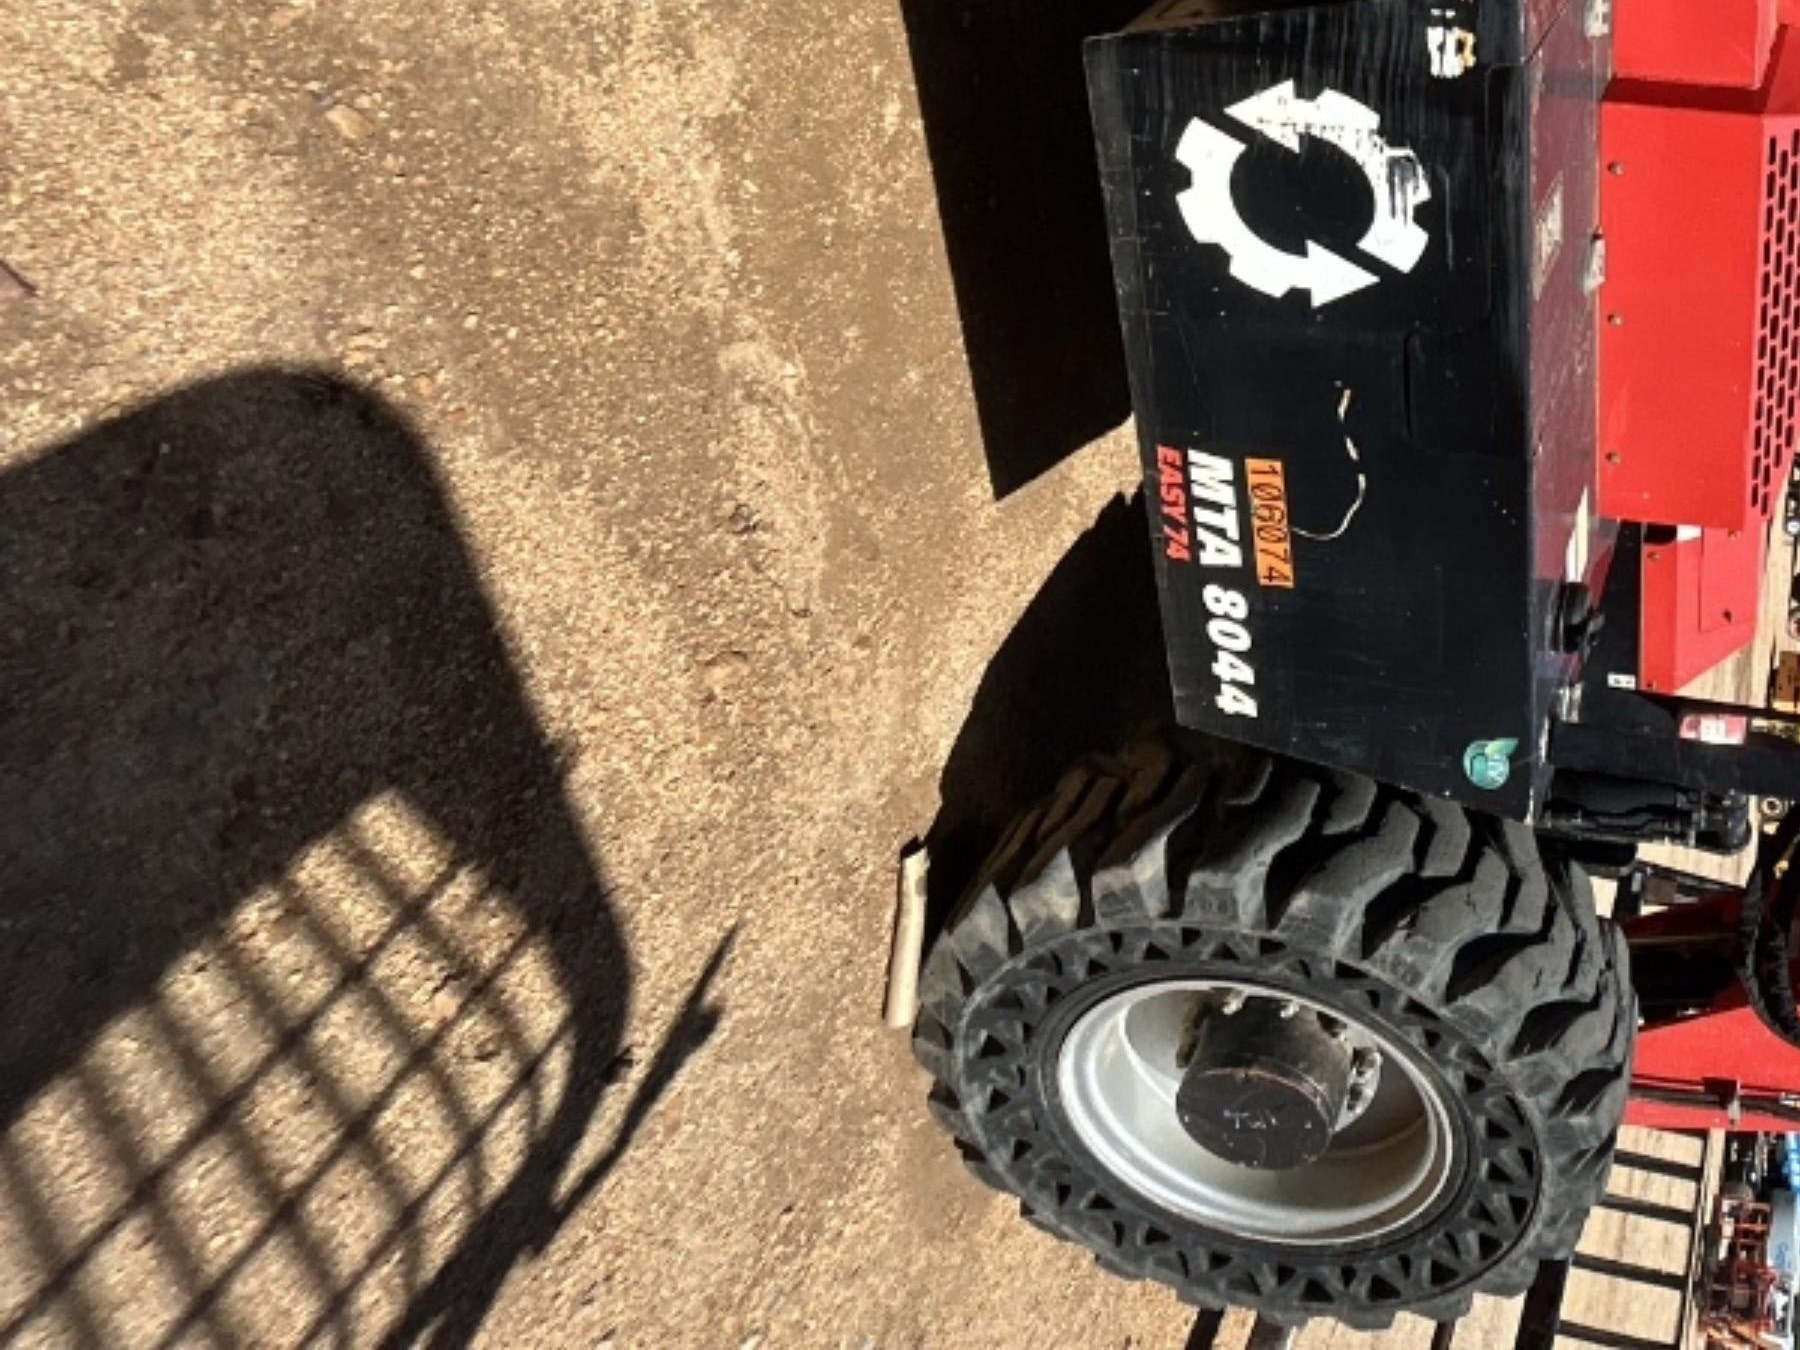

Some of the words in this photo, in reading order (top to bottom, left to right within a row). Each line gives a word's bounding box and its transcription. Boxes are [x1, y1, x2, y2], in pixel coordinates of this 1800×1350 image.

[1157, 445, 1187, 520] EASY
[1187, 449, 1242, 568] MTA
[1250, 463, 1289, 584] 106074
[1164, 524, 1190, 561] 74
[1203, 584, 1258, 718] 8044
